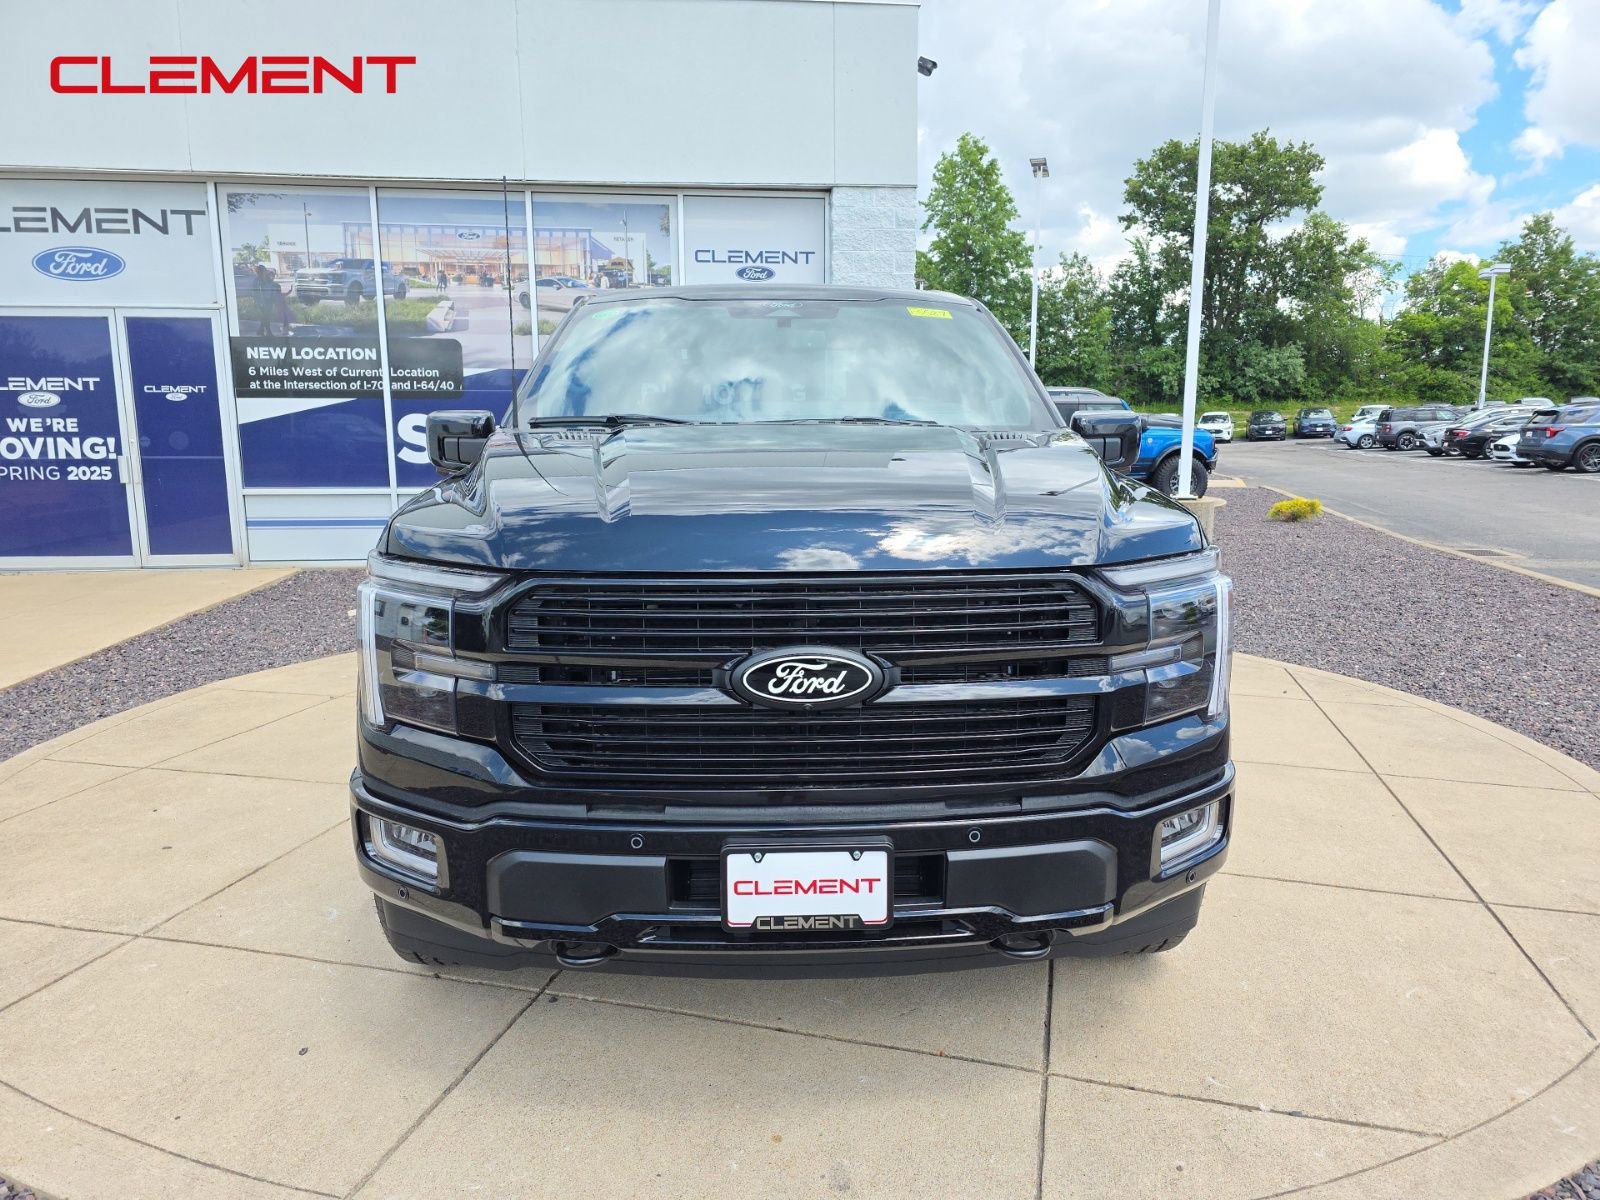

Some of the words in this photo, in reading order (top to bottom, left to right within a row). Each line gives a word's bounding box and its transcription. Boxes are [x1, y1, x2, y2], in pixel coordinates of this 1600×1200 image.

[50, 251, 108, 276] Ford
[694, 249, 816, 265] CLEMENT
[246, 347, 287, 360] NEW
[291, 347, 377, 360] LOCATION
[248, 366, 257, 376] 6
[260, 366, 289, 376] Miles
[292, 366, 322, 377] West
[325, 366, 338, 377] of
[341, 367, 384, 377] Current
[390, 367, 440, 377] Location
[144, 385, 207, 393] CLEMENT
[249, 380, 261, 390] at
[263, 380, 281, 390] the
[284, 381, 347, 390] Intersection
[349, 381, 362, 390] of
[391, 381, 411, 390] and
[413, 380, 455, 392] I-64/40
[6, 418, 79, 433] WE'RE
[67, 466, 112, 481] 2025
[768, 662, 848, 694] Ford
[733, 878, 881, 896] CLEMENT
[756, 916, 859, 930] CLEMENT
